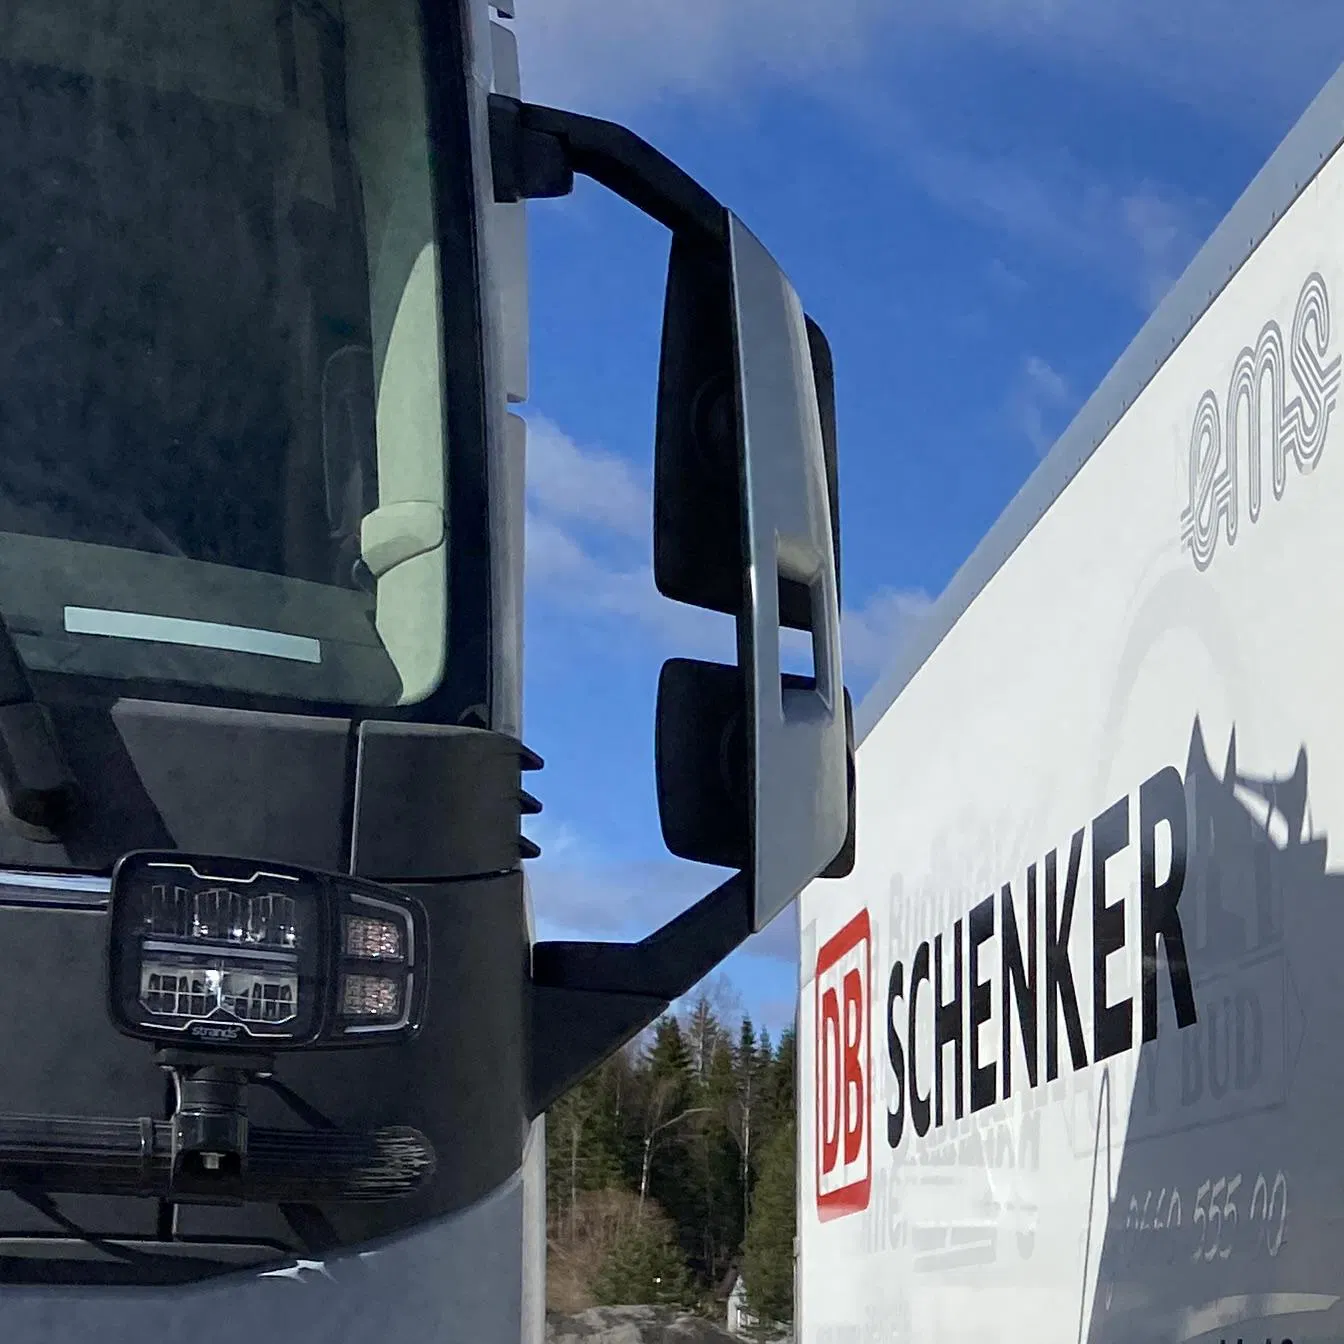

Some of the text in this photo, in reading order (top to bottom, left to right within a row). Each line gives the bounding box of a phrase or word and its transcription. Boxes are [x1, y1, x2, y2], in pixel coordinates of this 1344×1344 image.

[1181, 272, 1342, 572] ems
[192, 1026, 238, 1038] strands
[821, 967, 864, 1177] DB
[886, 766, 1198, 1149] SCHENKER
